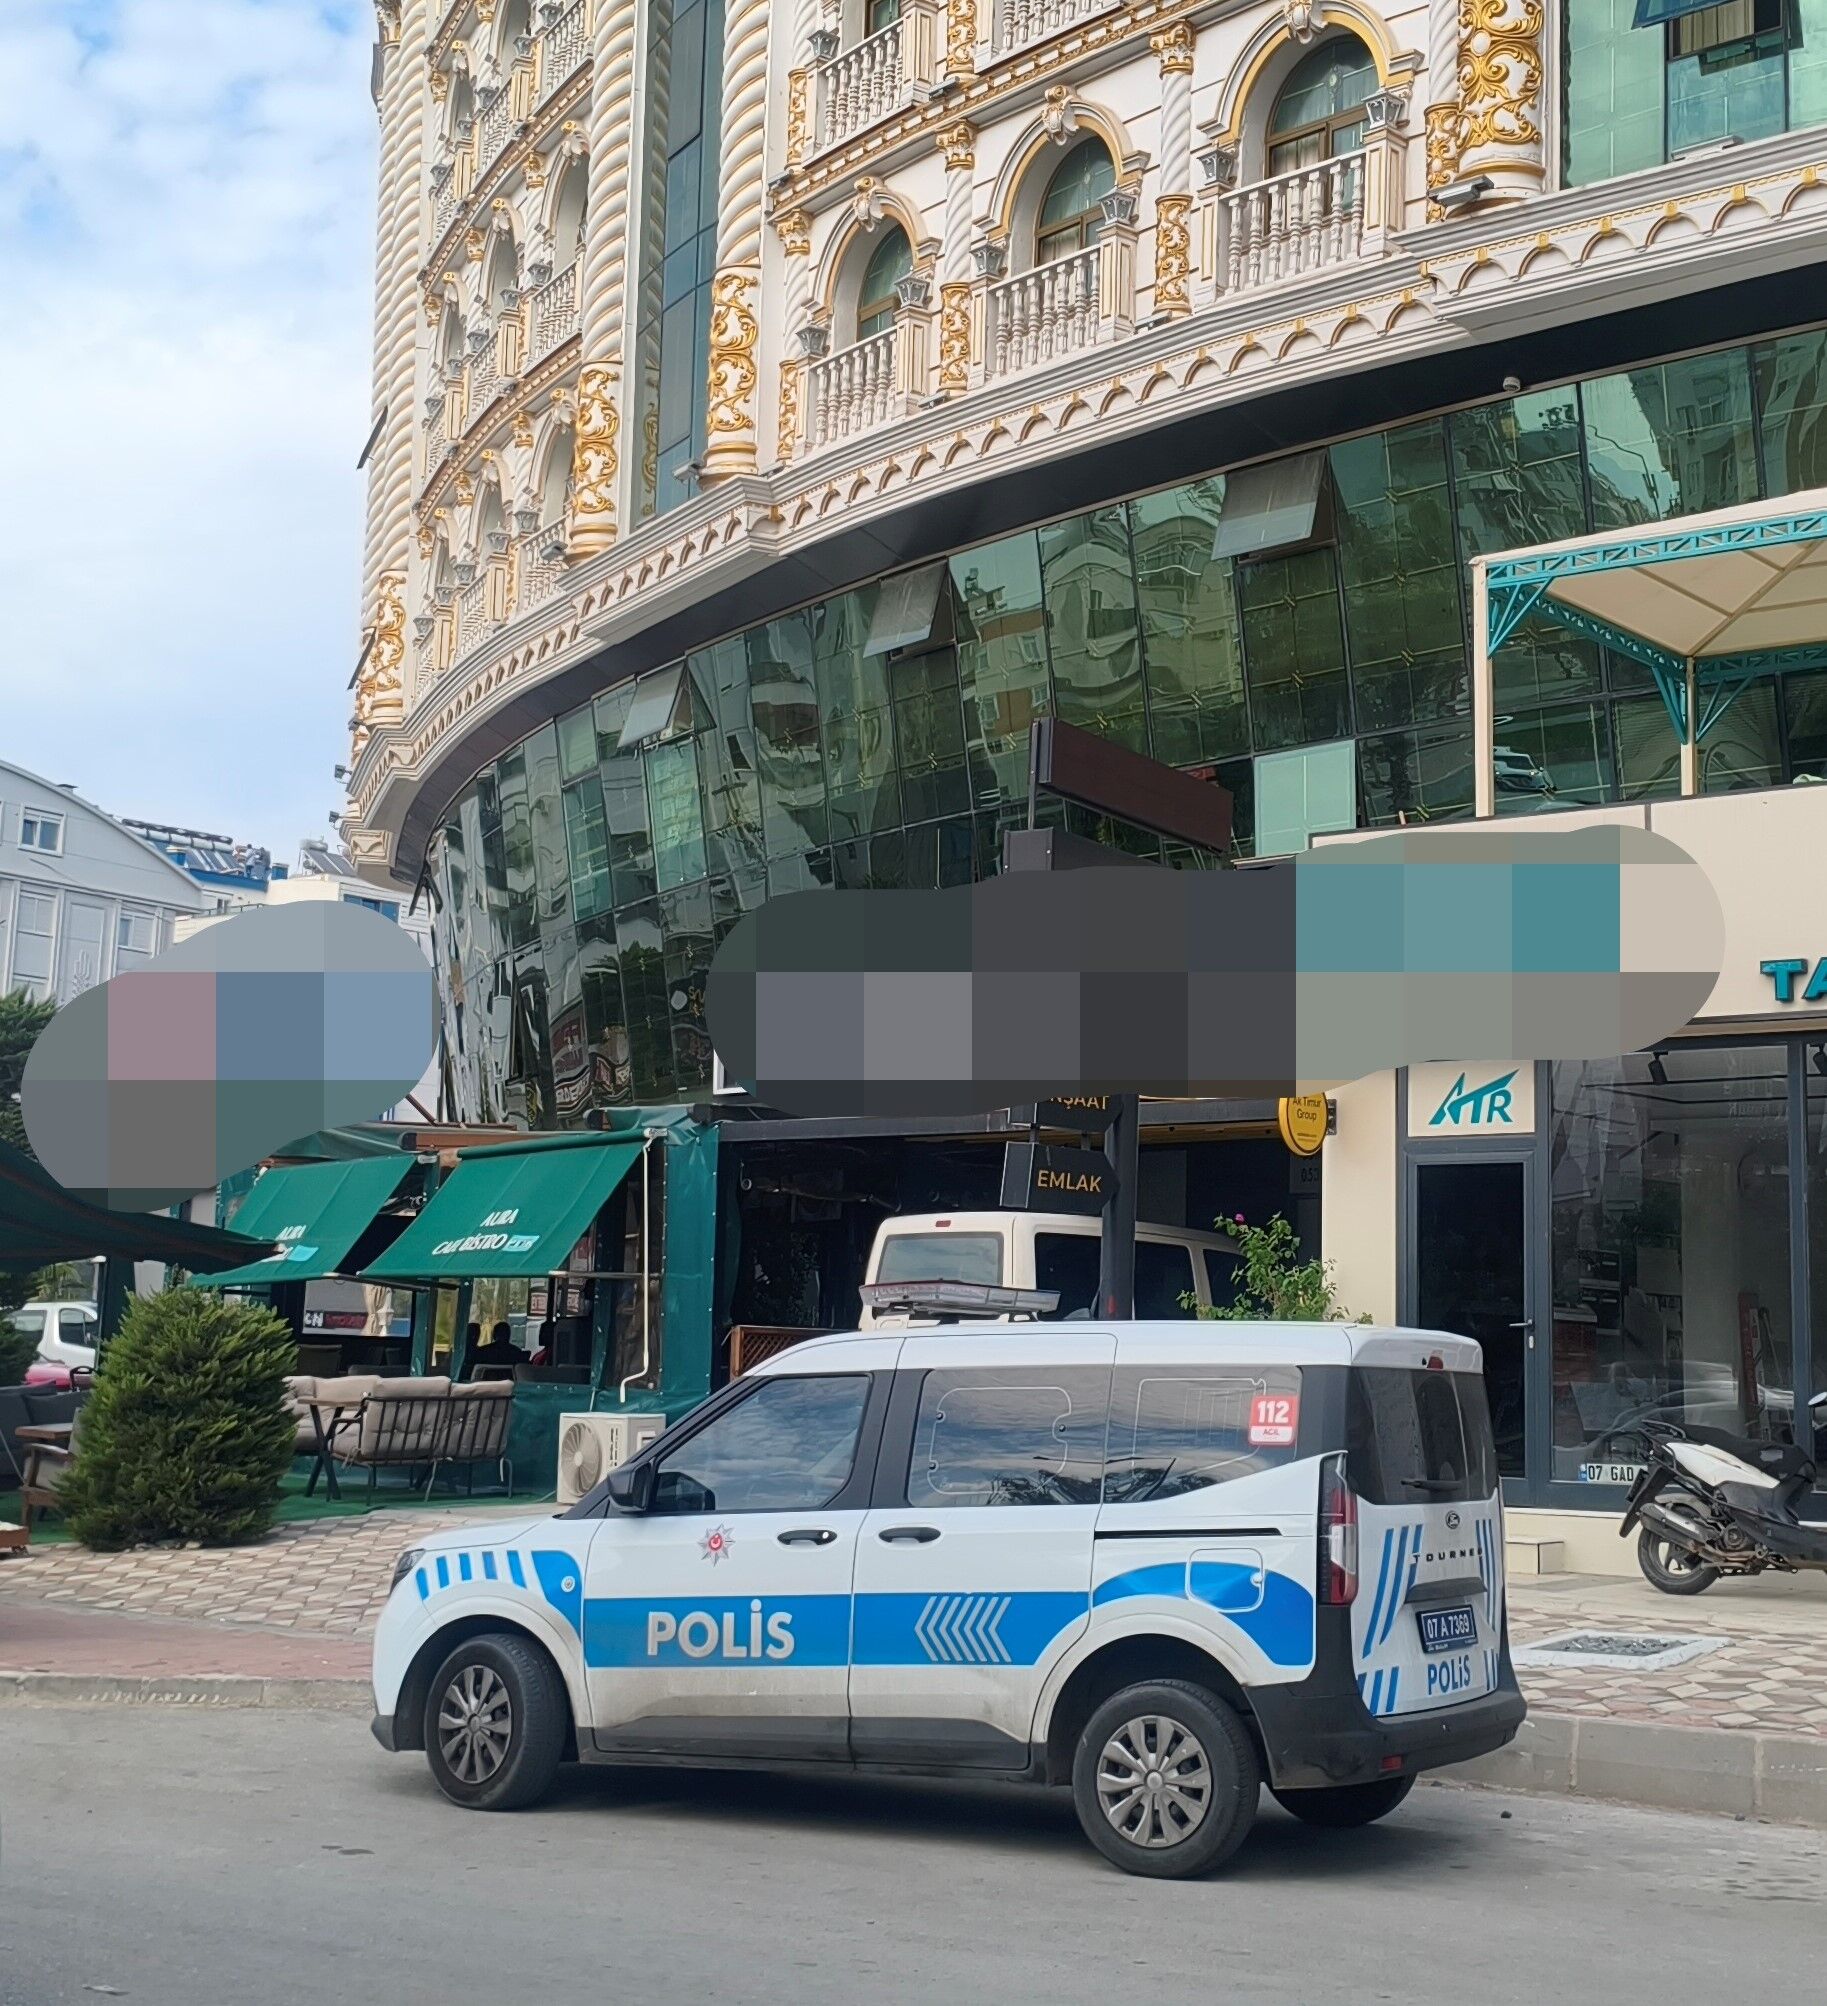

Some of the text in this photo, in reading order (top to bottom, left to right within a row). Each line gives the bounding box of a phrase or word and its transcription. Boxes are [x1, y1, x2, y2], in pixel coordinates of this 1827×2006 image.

[1428, 1068, 1520, 1125] ATR
[1297, 1108, 1317, 1121] Group
[1037, 1169, 1102, 1193] EMLAK
[480, 1208, 519, 1227] AURA
[1257, 1400, 1290, 1424] 112
[1588, 1465, 1634, 1482] 07 GAD
[647, 1599, 795, 1660] POLİS
[1427, 1613, 1470, 1639] 07 A 7369
[1427, 1654, 1471, 1695] POLİS
